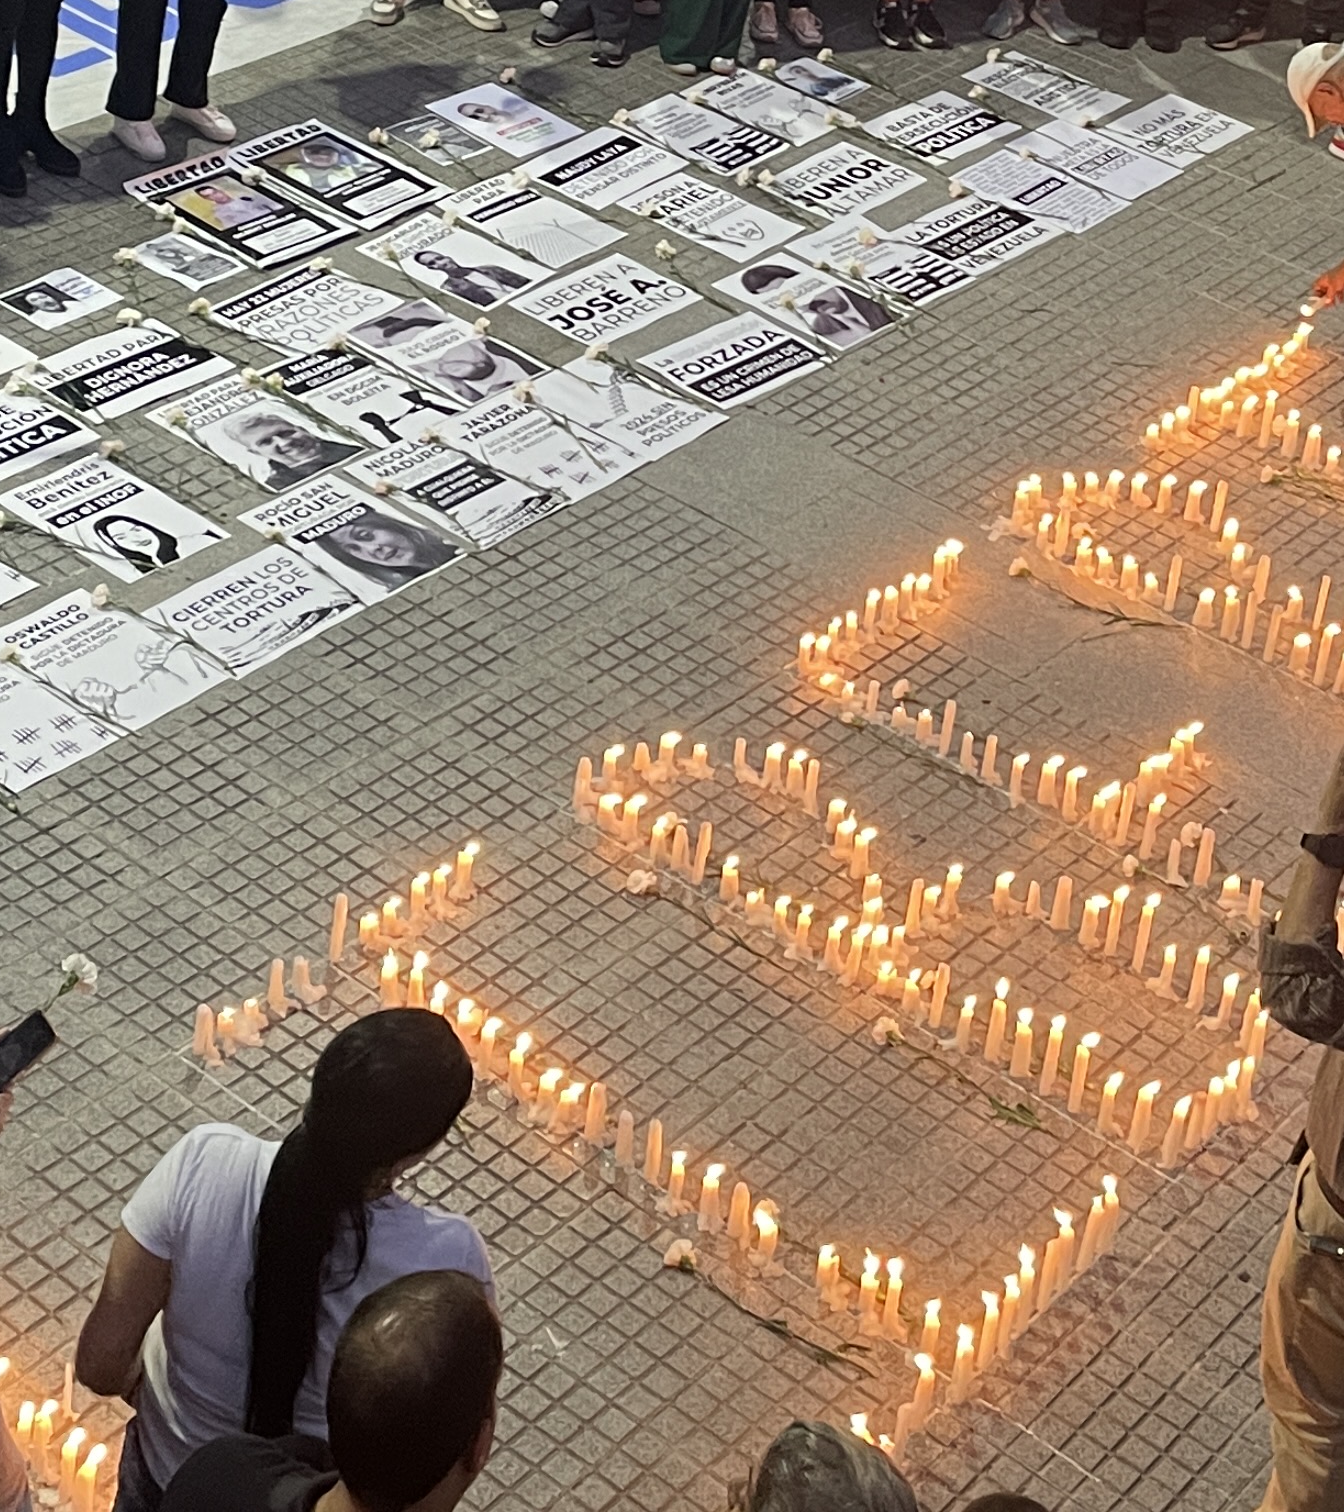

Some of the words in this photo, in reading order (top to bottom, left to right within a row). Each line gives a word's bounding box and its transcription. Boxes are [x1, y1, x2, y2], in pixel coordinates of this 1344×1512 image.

[886, 110, 933, 133] BASTA
[932, 102, 952, 116] DE
[897, 103, 978, 143] ERSECUCIÓN
[918, 116, 997, 155] POLÍTICA
[1136, 118, 1202, 153] TORTURA
[236, 122, 324, 161] LIBERTAD
[846, 149, 866, 161] A
[1159, 119, 1236, 159] VENEZUELA
[135, 155, 226, 194] LIBERTAD
[449, 178, 507, 205] LIBERTAD
[575, 172, 622, 202] PENSAR
[619, 152, 668, 181] DISTINTO
[797, 158, 892, 207] JUNIOR
[823, 168, 913, 218] ALTAMAR
[472, 189, 507, 206] PARA
[906, 229, 926, 244] LA
[925, 197, 997, 234] TORTURA
[962, 226, 1003, 253] ESTADO
[959, 226, 1049, 269] VENEZUELA
[220, 301, 253, 319] HAY
[250, 293, 269, 307] 22
[237, 294, 307, 329] PRESAS
[305, 276, 345, 298] POR
[523, 269, 616, 316] LIBEREN
[616, 262, 639, 275] A
[546, 287, 633, 331] JOSÉ
[629, 276, 667, 295] A.
[258, 285, 363, 341] RAZONES
[274, 293, 386, 348] POLÍTICAS
[571, 286, 687, 343] BARRENO
[33, 348, 122, 388] LIBERTAD
[83, 351, 171, 388] DIGNORA
[288, 352, 330, 373] MARÍA
[668, 329, 787, 383] FORZADA
[698, 378, 719, 393] ES
[717, 369, 739, 384] UN
[736, 352, 784, 378] CRIMEN
[780, 343, 803, 358] DE
[710, 382, 745, 400] LESA
[742, 350, 815, 388] HUMANIDAD
[84, 352, 199, 404] HERNÁNDEZ
[185, 380, 249, 418] EJANDRO
[191, 390, 267, 428] ONZÁLEZ
[459, 403, 512, 431] JAVIER
[460, 405, 535, 443] TARAZONA
[636, 409, 688, 436] PRESOS
[641, 411, 708, 448] POLÍTICOS
[376, 445, 448, 478] MADURO
[25, 468, 117, 511] Benítez
[55, 509, 82, 526] en
[79, 501, 97, 518] el
[92, 482, 141, 511] INOF
[254, 497, 301, 522] ROCÍO
[299, 481, 335, 499] SAN
[267, 491, 352, 527] MIGUEL
[302, 505, 367, 541] MADURO
[172, 575, 258, 623] CIERREN
[253, 556, 294, 581] LOS
[191, 581, 280, 632] CENTROS
[277, 566, 310, 586] DE
[219, 584, 314, 635] TORTURA
[4, 603, 81, 645] OSWALDO
[18, 611, 90, 650] CASTILLO
[61, 616, 114, 646] DETENIDO
[30, 658, 53, 672] POR
[66, 619, 127, 654] DICTADURA
[70, 633, 118, 662] MADURO
